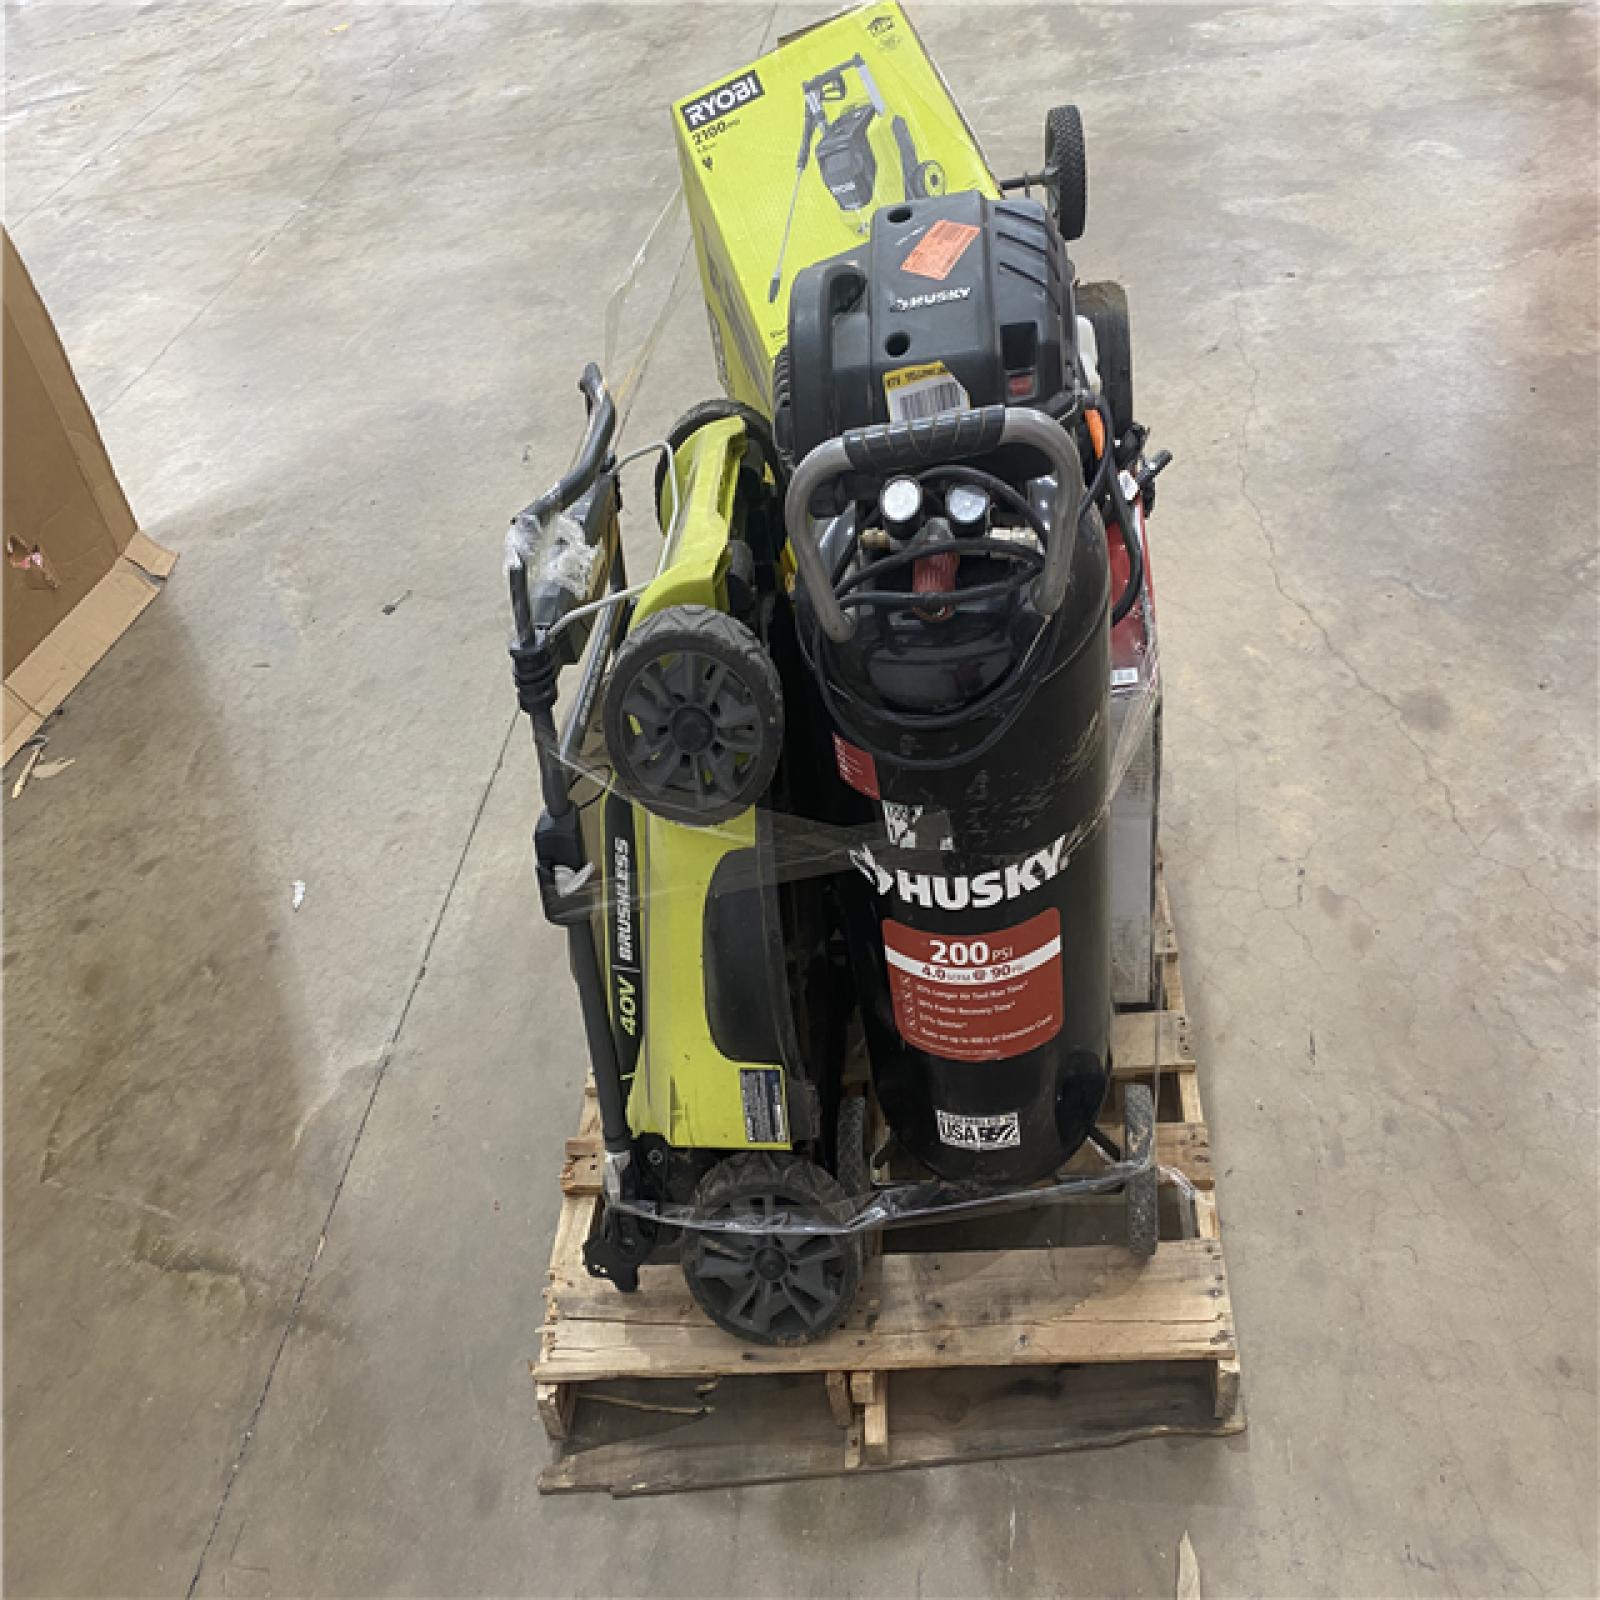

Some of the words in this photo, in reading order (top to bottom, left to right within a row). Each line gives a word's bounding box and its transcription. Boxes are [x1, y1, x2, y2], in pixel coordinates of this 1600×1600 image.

[684, 76, 760, 126] RYOBI
[909, 286, 972, 309] HUSKY
[614, 837, 634, 961] BRUSHLESS
[896, 834, 1067, 910] HUSKY
[929, 939, 990, 966] 200
[991, 946, 1014, 962] PSI
[617, 974, 636, 1036] 40V
